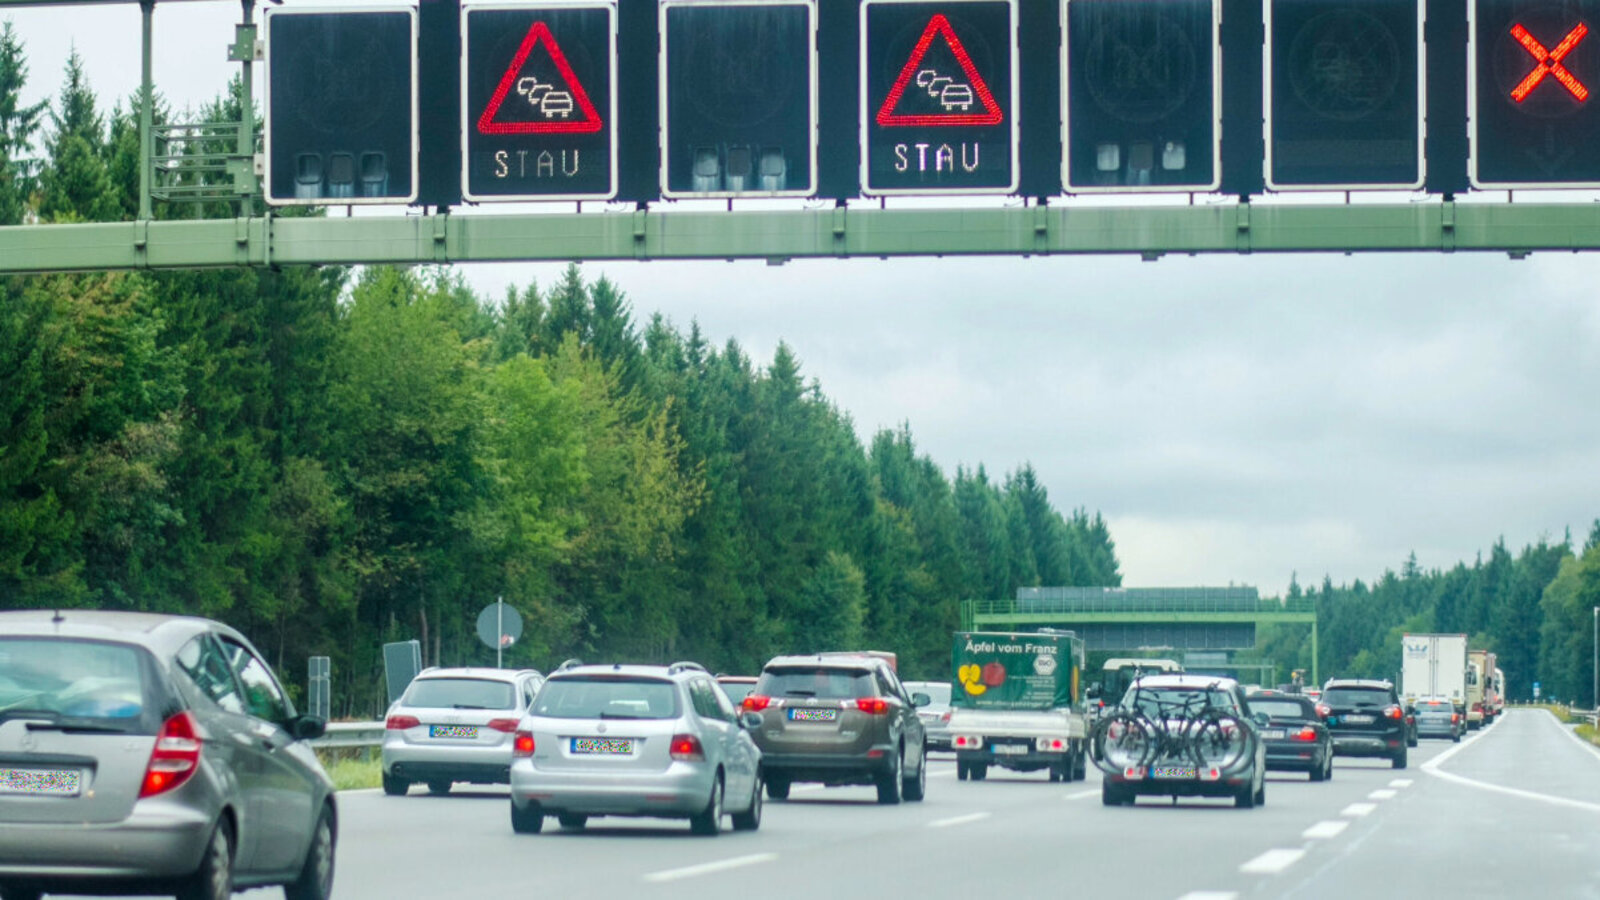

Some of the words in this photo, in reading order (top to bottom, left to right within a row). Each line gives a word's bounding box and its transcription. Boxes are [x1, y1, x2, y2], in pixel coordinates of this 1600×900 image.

[495, 149, 579, 178] STAU
[894, 143, 979, 172] STAU
[965, 639, 995, 654] Äpfel
[997, 643, 1022, 653] vom
[1025, 643, 1057, 654] Franz
